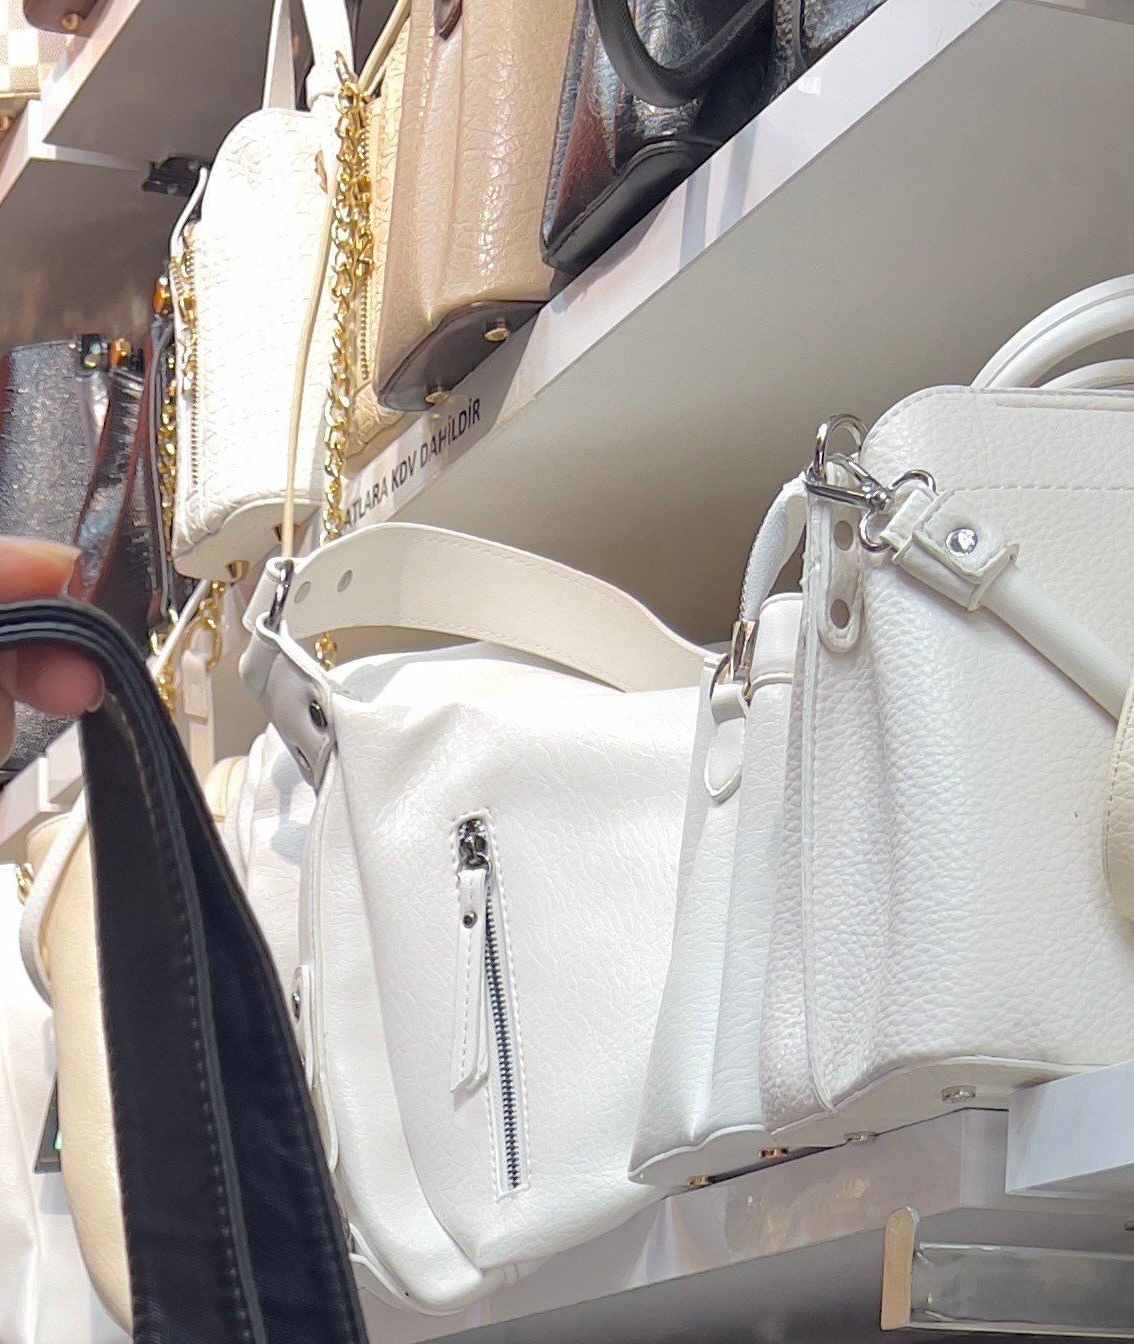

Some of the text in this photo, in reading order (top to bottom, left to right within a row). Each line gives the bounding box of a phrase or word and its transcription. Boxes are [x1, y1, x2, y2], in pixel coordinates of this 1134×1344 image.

[344, 398, 481, 527] ATLARA KDV DAHİLDİR
